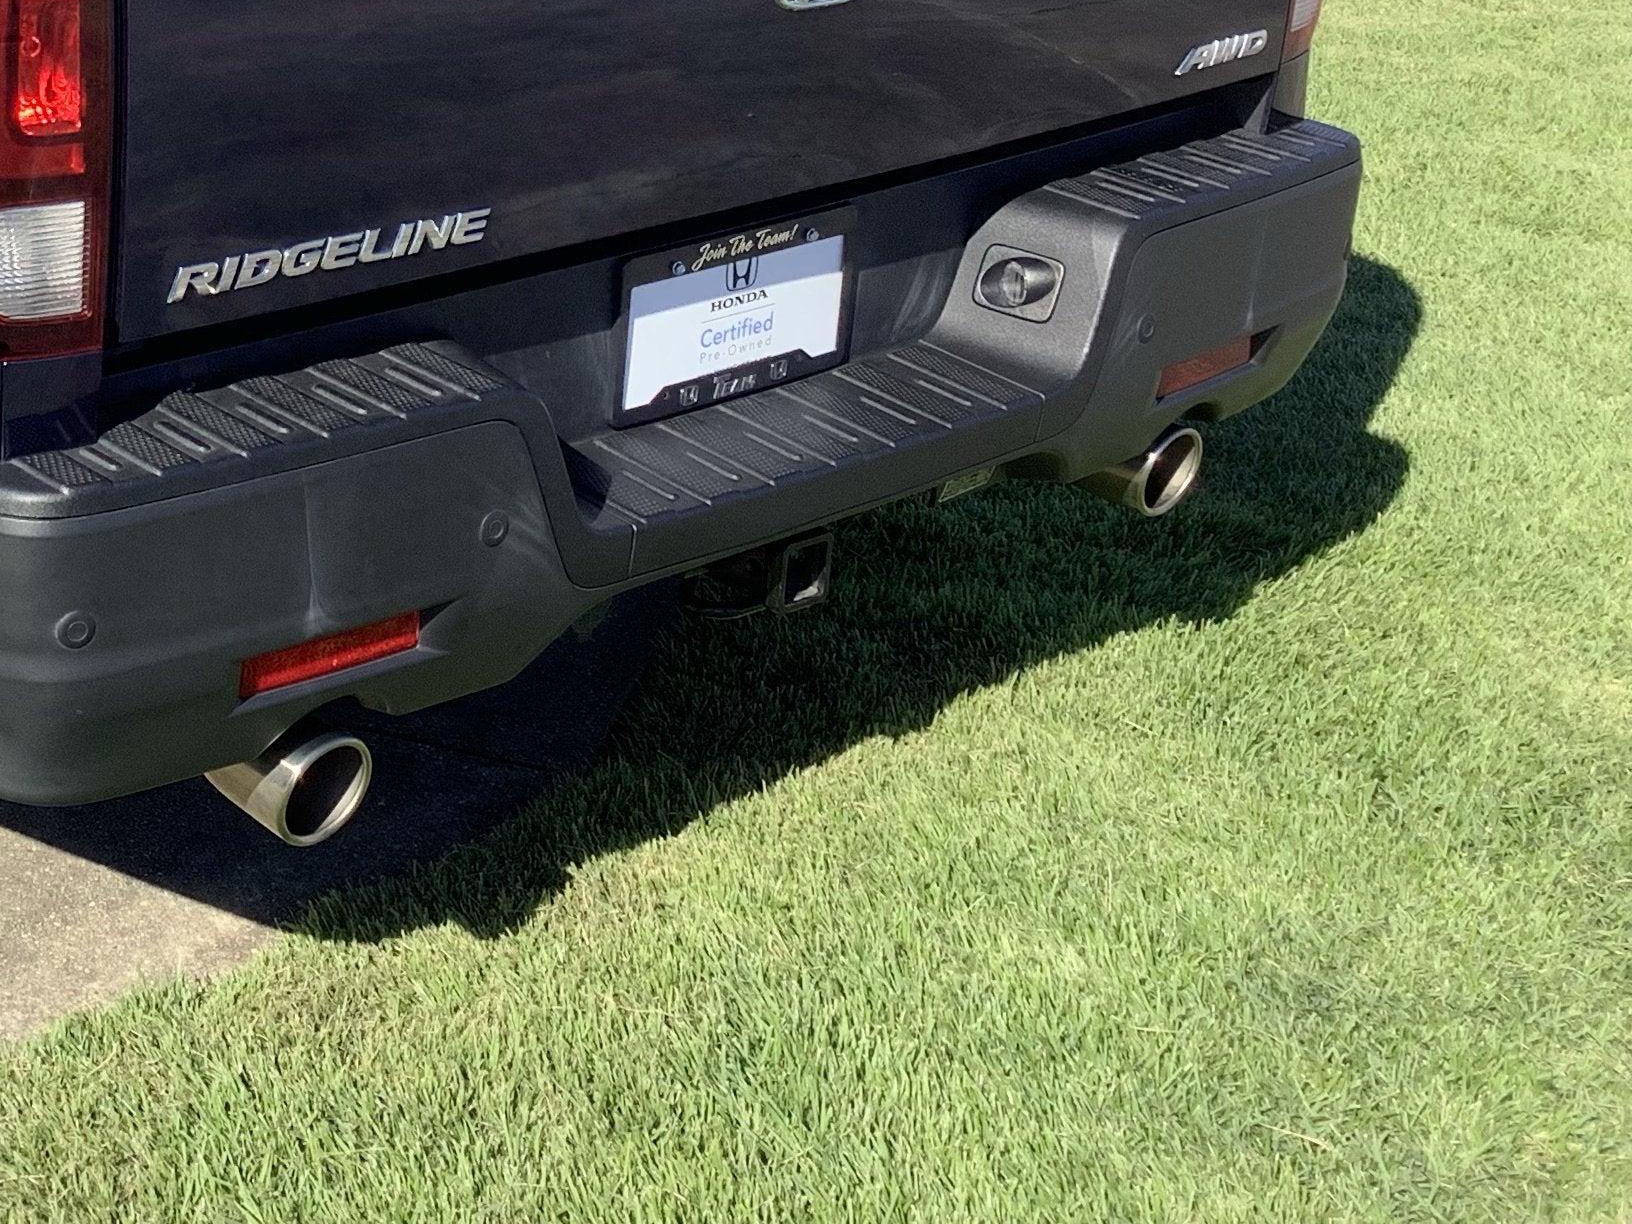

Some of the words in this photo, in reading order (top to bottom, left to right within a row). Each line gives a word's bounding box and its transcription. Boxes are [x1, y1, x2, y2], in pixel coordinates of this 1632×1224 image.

[1174, 29, 1268, 75] AWD
[167, 207, 491, 304] RIDGELINE
[692, 243, 727, 271] Join
[729, 234, 753, 258] The
[756, 224, 799, 253] Team!
[710, 289, 769, 312] HONDA
[699, 336, 772, 364] Pre-Owned
[700, 311, 774, 349] Certified
